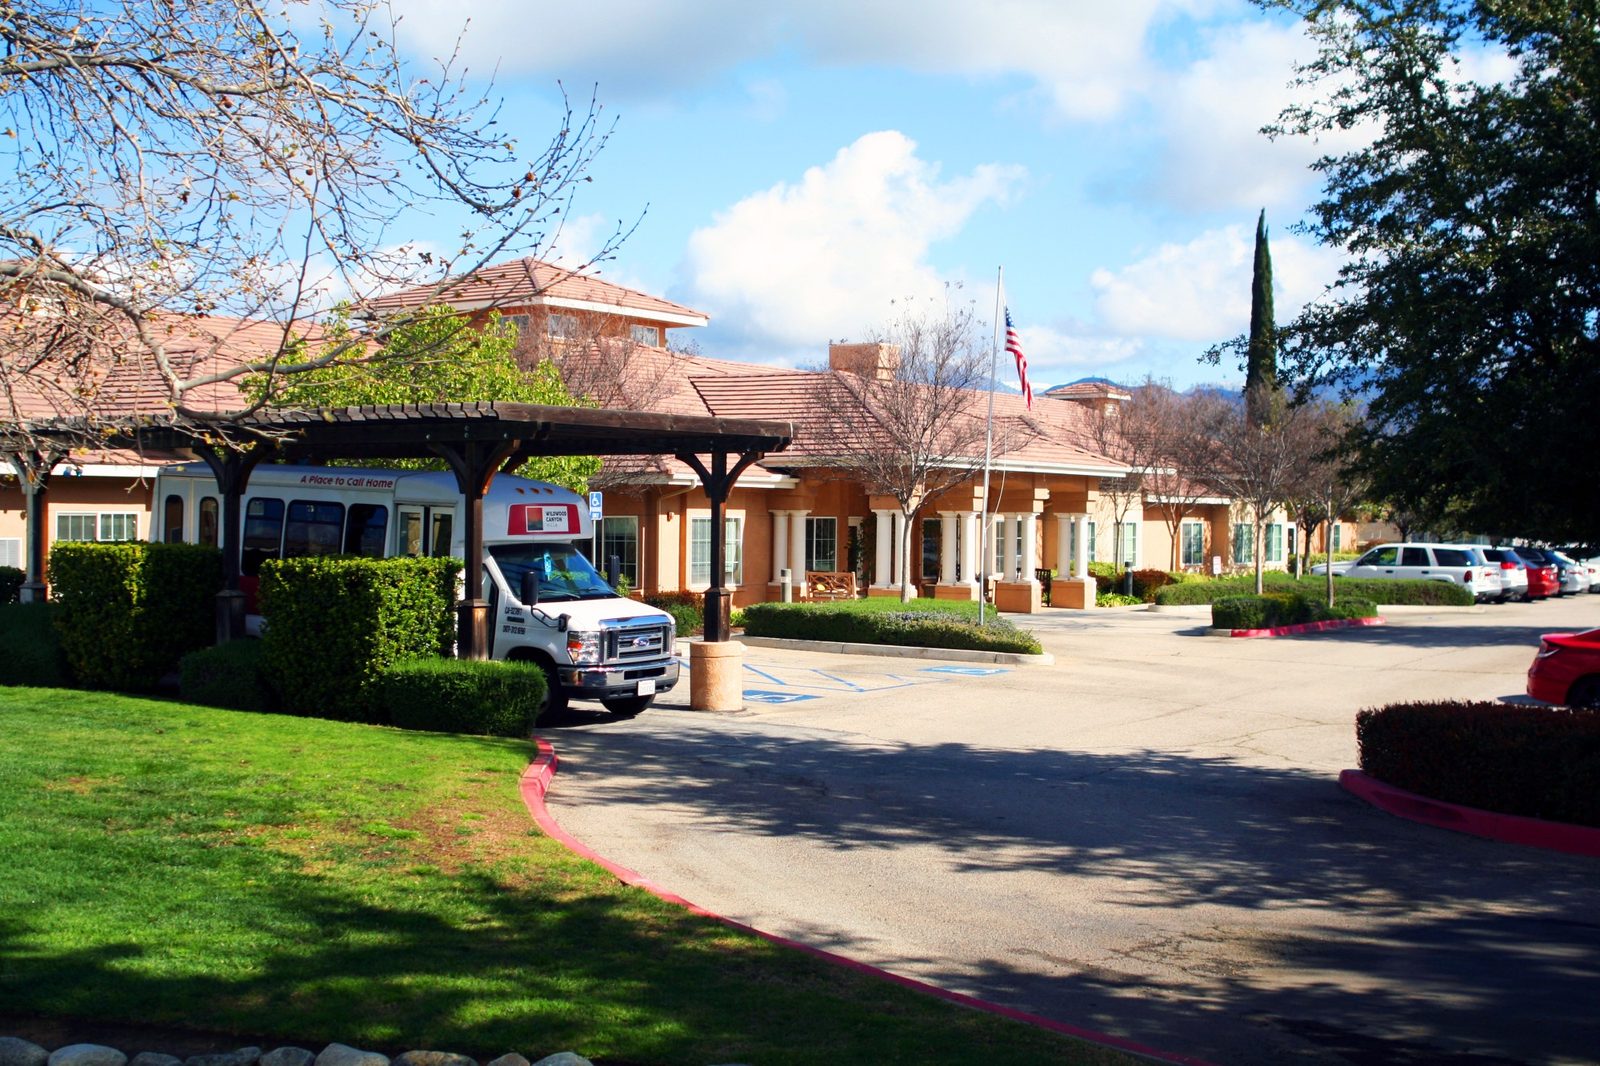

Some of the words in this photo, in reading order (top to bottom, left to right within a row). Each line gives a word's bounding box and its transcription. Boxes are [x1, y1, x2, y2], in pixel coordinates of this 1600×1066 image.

[301, 475, 307, 484] A
[309, 475, 332, 485] Place
[335, 477, 344, 486] to
[346, 477, 364, 487] Call
[366, 479, 393, 488] Home
